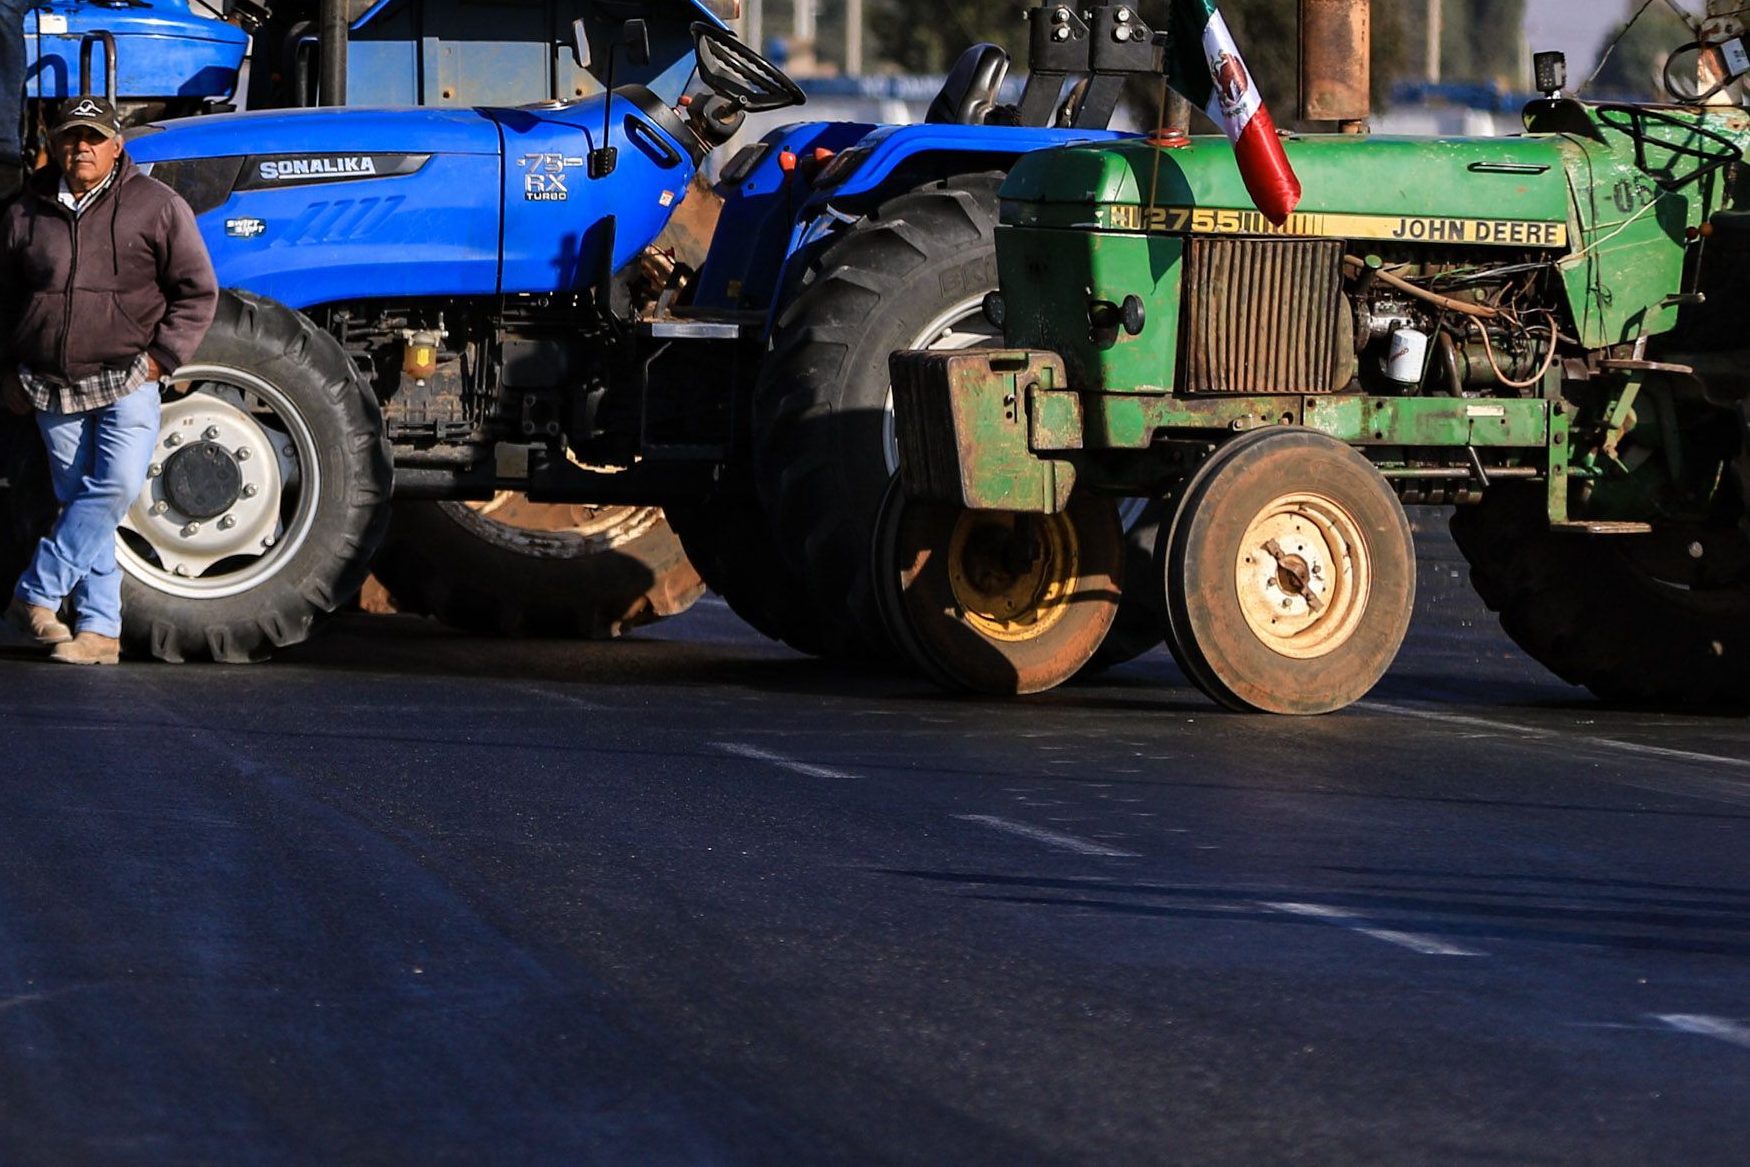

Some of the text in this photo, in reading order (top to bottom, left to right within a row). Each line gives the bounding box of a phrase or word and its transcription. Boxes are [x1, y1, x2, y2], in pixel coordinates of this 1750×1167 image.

[259, 156, 376, 180] SONALIKA
[525, 174, 568, 192] RX
[526, 192, 568, 201] TURBO
[1144, 208, 1241, 232] 2755
[1393, 218, 1559, 245] JOHN DEERE
